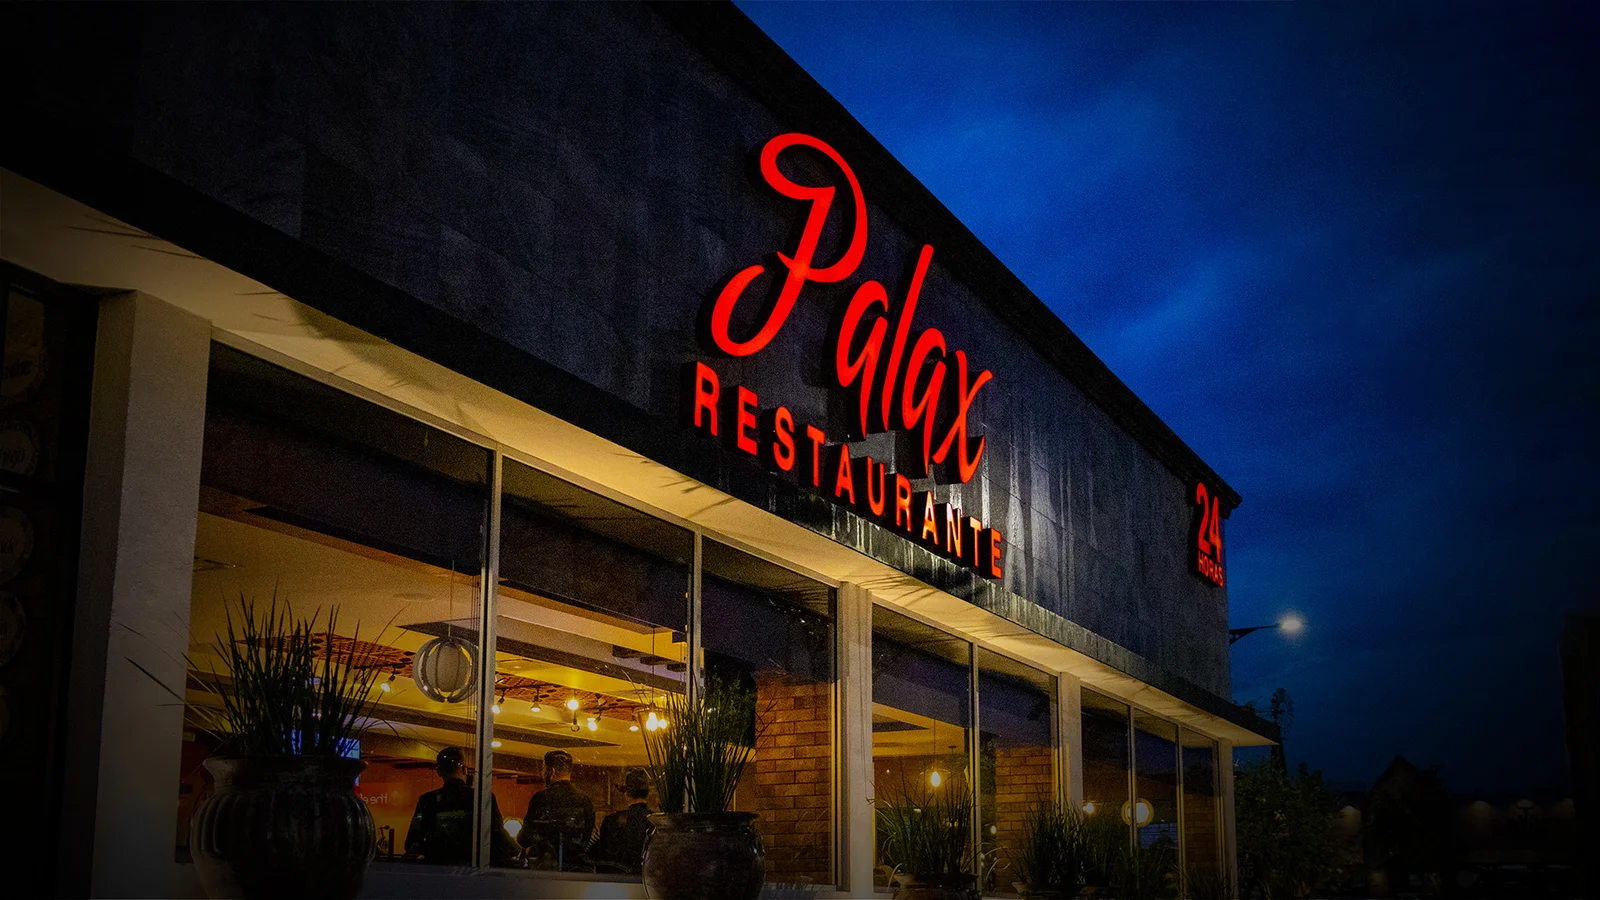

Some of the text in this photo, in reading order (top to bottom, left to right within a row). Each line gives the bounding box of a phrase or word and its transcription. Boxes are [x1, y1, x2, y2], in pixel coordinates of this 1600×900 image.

[711, 132, 993, 484] Palax
[694, 361, 1003, 579] RESTAURANTE
[1196, 482, 1222, 563] 24
[1197, 550, 1224, 588] HORAS
